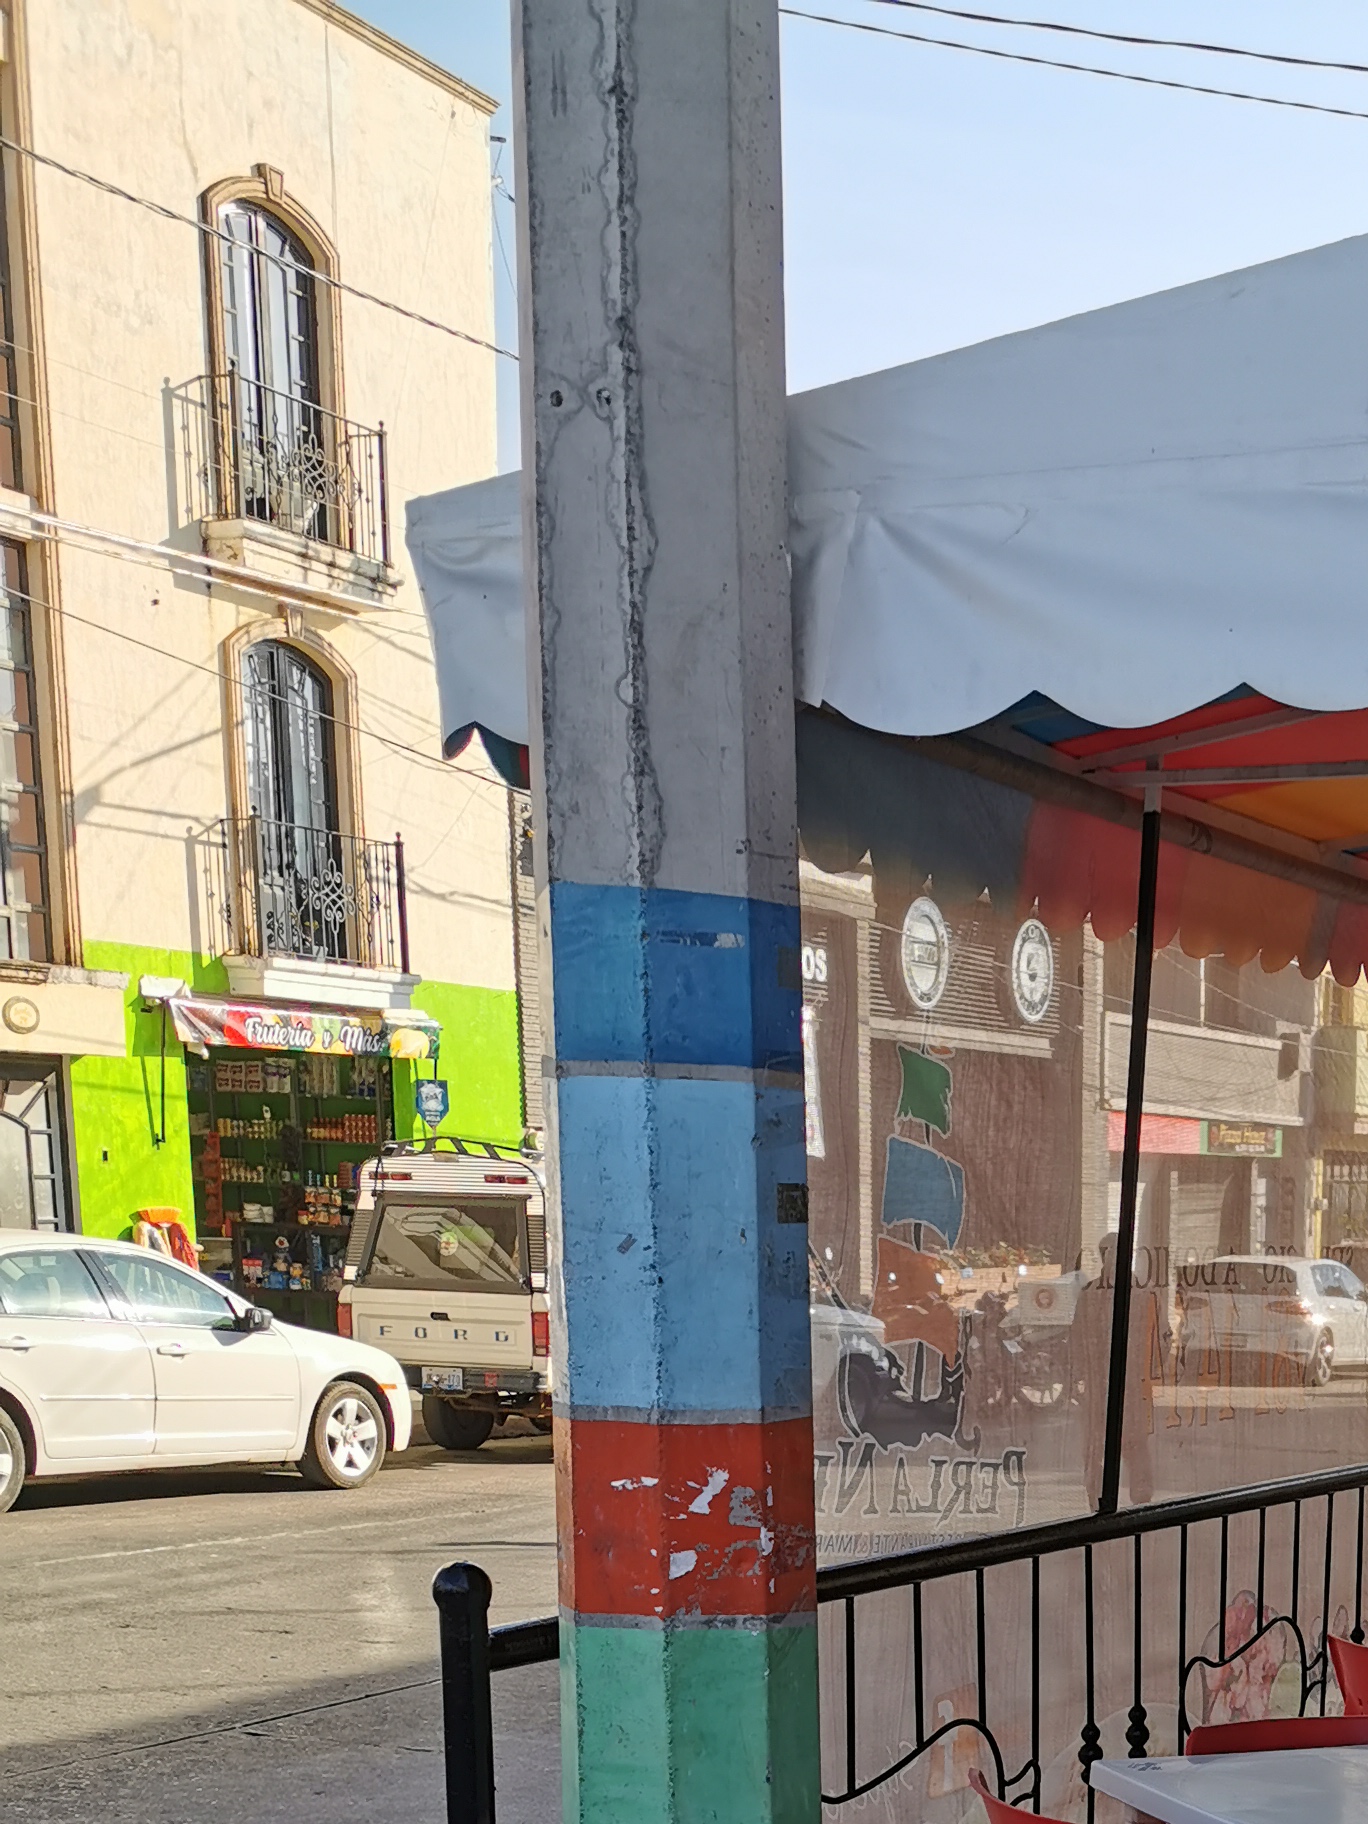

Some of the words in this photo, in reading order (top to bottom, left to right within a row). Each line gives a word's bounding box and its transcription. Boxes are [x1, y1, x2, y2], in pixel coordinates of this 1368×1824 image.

[245, 1016, 315, 1048] Frutería
[322, 1029, 333, 1049] y
[379, 1325, 509, 1342] FORD
